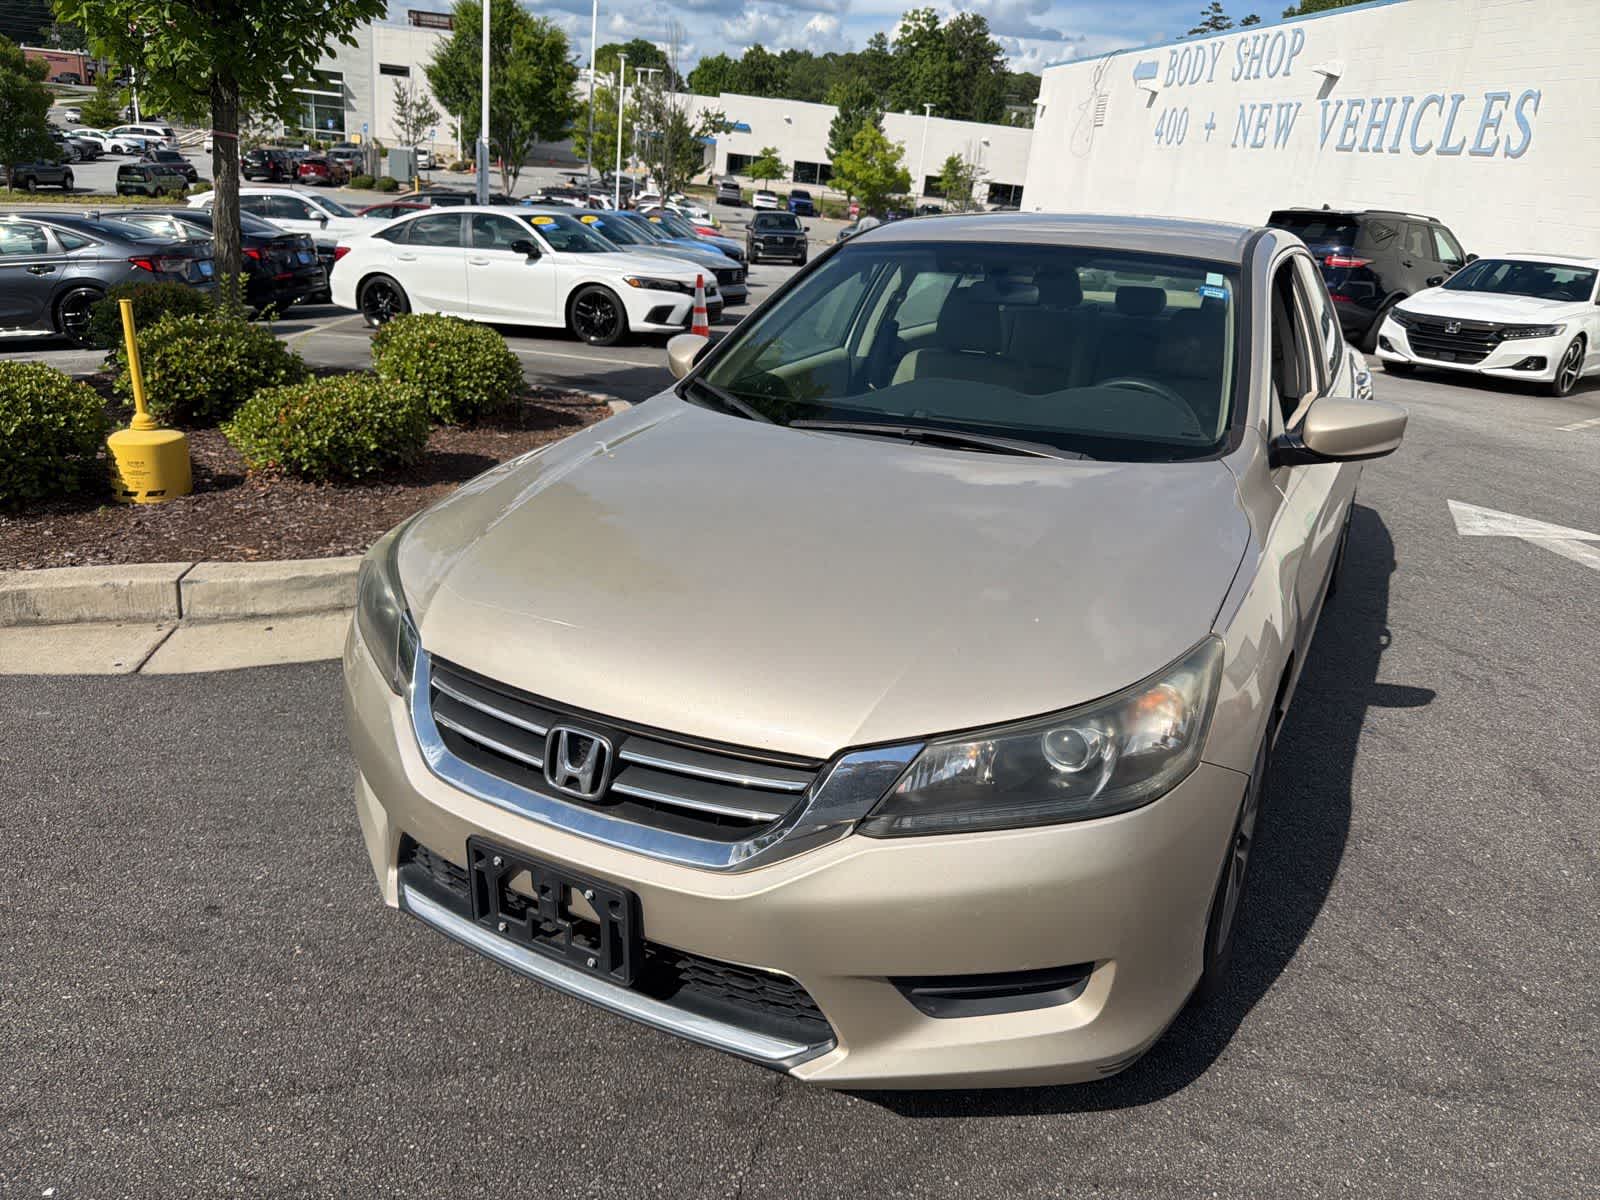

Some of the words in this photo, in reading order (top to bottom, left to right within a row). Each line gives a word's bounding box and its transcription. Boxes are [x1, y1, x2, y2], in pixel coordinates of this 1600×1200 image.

[1163, 41, 1225, 88] BODY
[1231, 28, 1306, 82] SHOP
[1155, 106, 1189, 146] 400
[1204, 111, 1217, 143] +
[1231, 102, 1303, 150] NEW
[1320, 89, 1542, 159] VEHICLES
